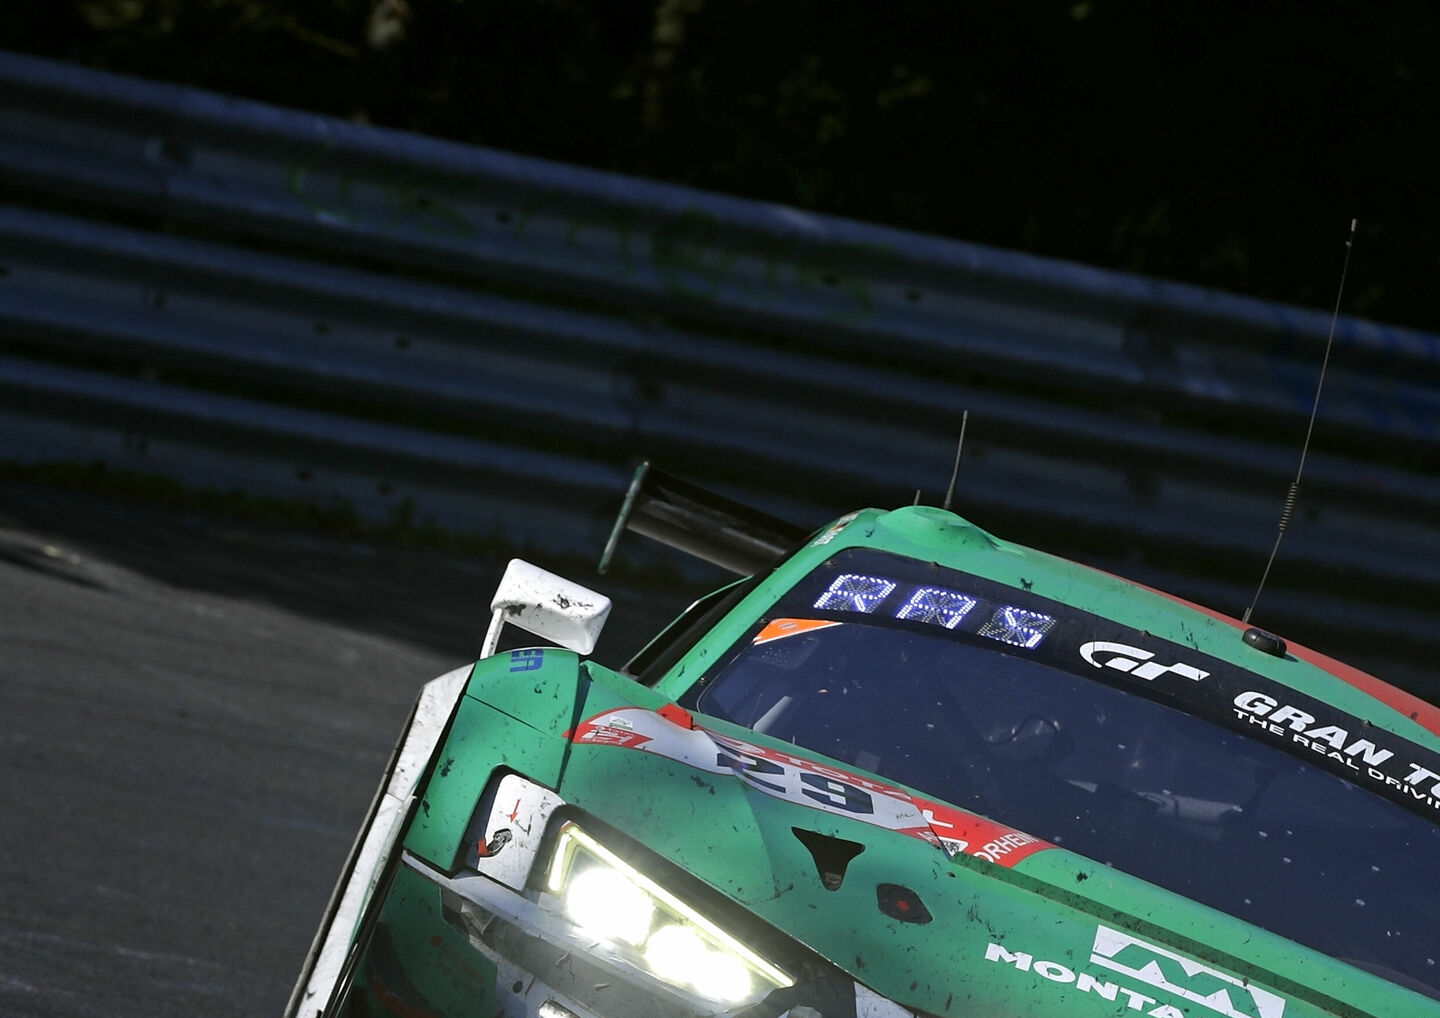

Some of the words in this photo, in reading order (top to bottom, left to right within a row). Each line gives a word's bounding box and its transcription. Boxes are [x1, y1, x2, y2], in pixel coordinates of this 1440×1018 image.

[813, 572, 1057, 649] RAS
[1233, 690, 1395, 768] GRAN
[1233, 708, 1287, 737] THE
[1293, 732, 1359, 771] REAL
[716, 745, 875, 815] 29
